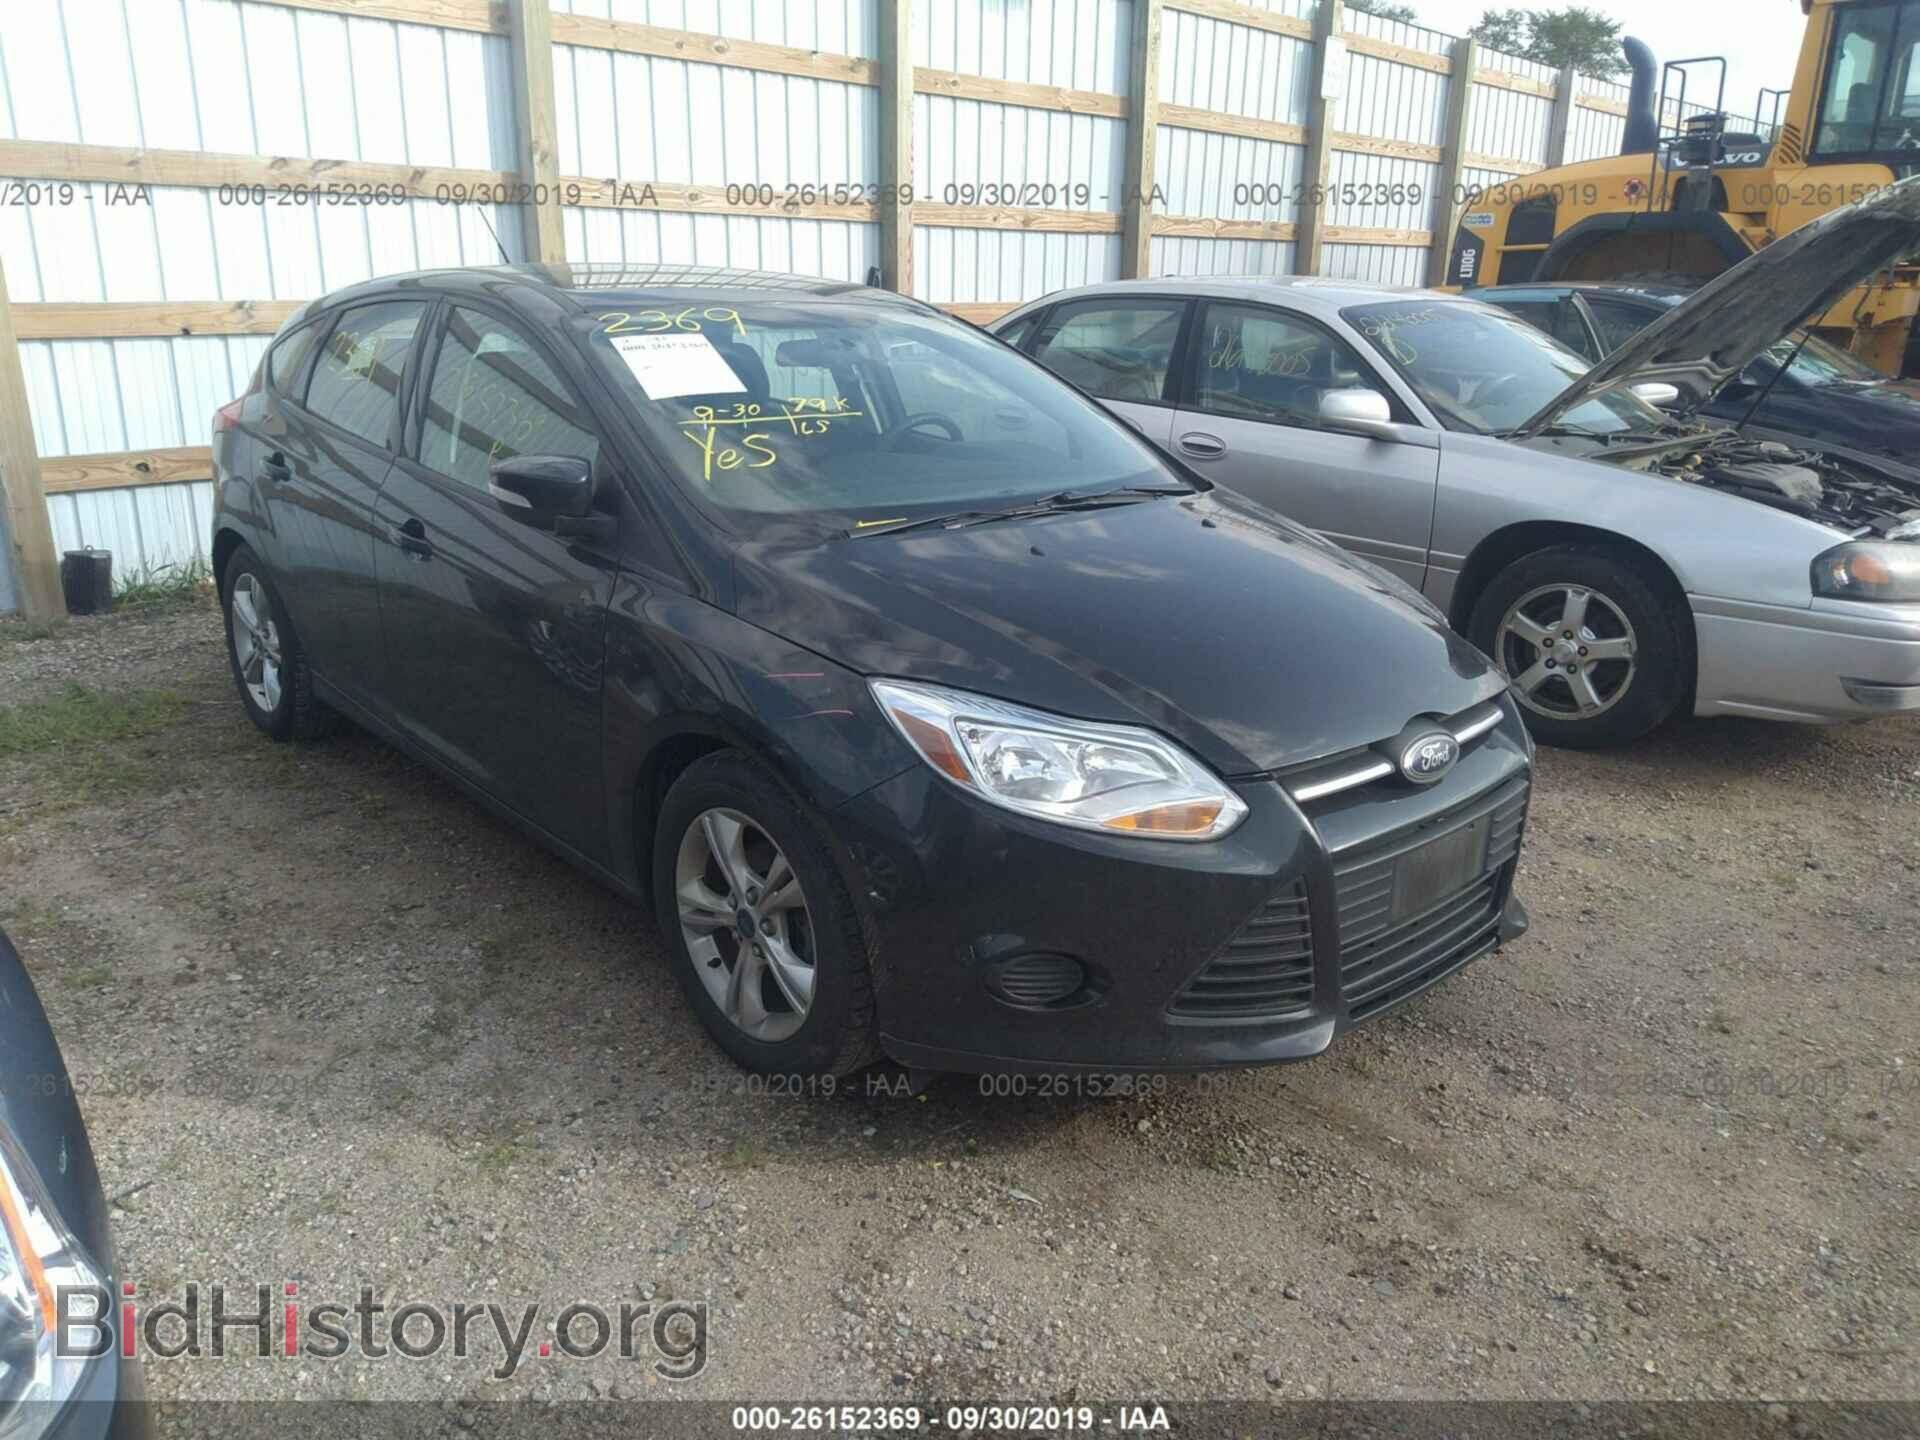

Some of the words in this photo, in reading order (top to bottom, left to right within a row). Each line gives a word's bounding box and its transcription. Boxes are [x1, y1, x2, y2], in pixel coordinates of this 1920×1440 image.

[598, 307, 747, 336] 2369
[693, 403, 761, 424] 9-30
[1421, 742, 1450, 769] Ford
